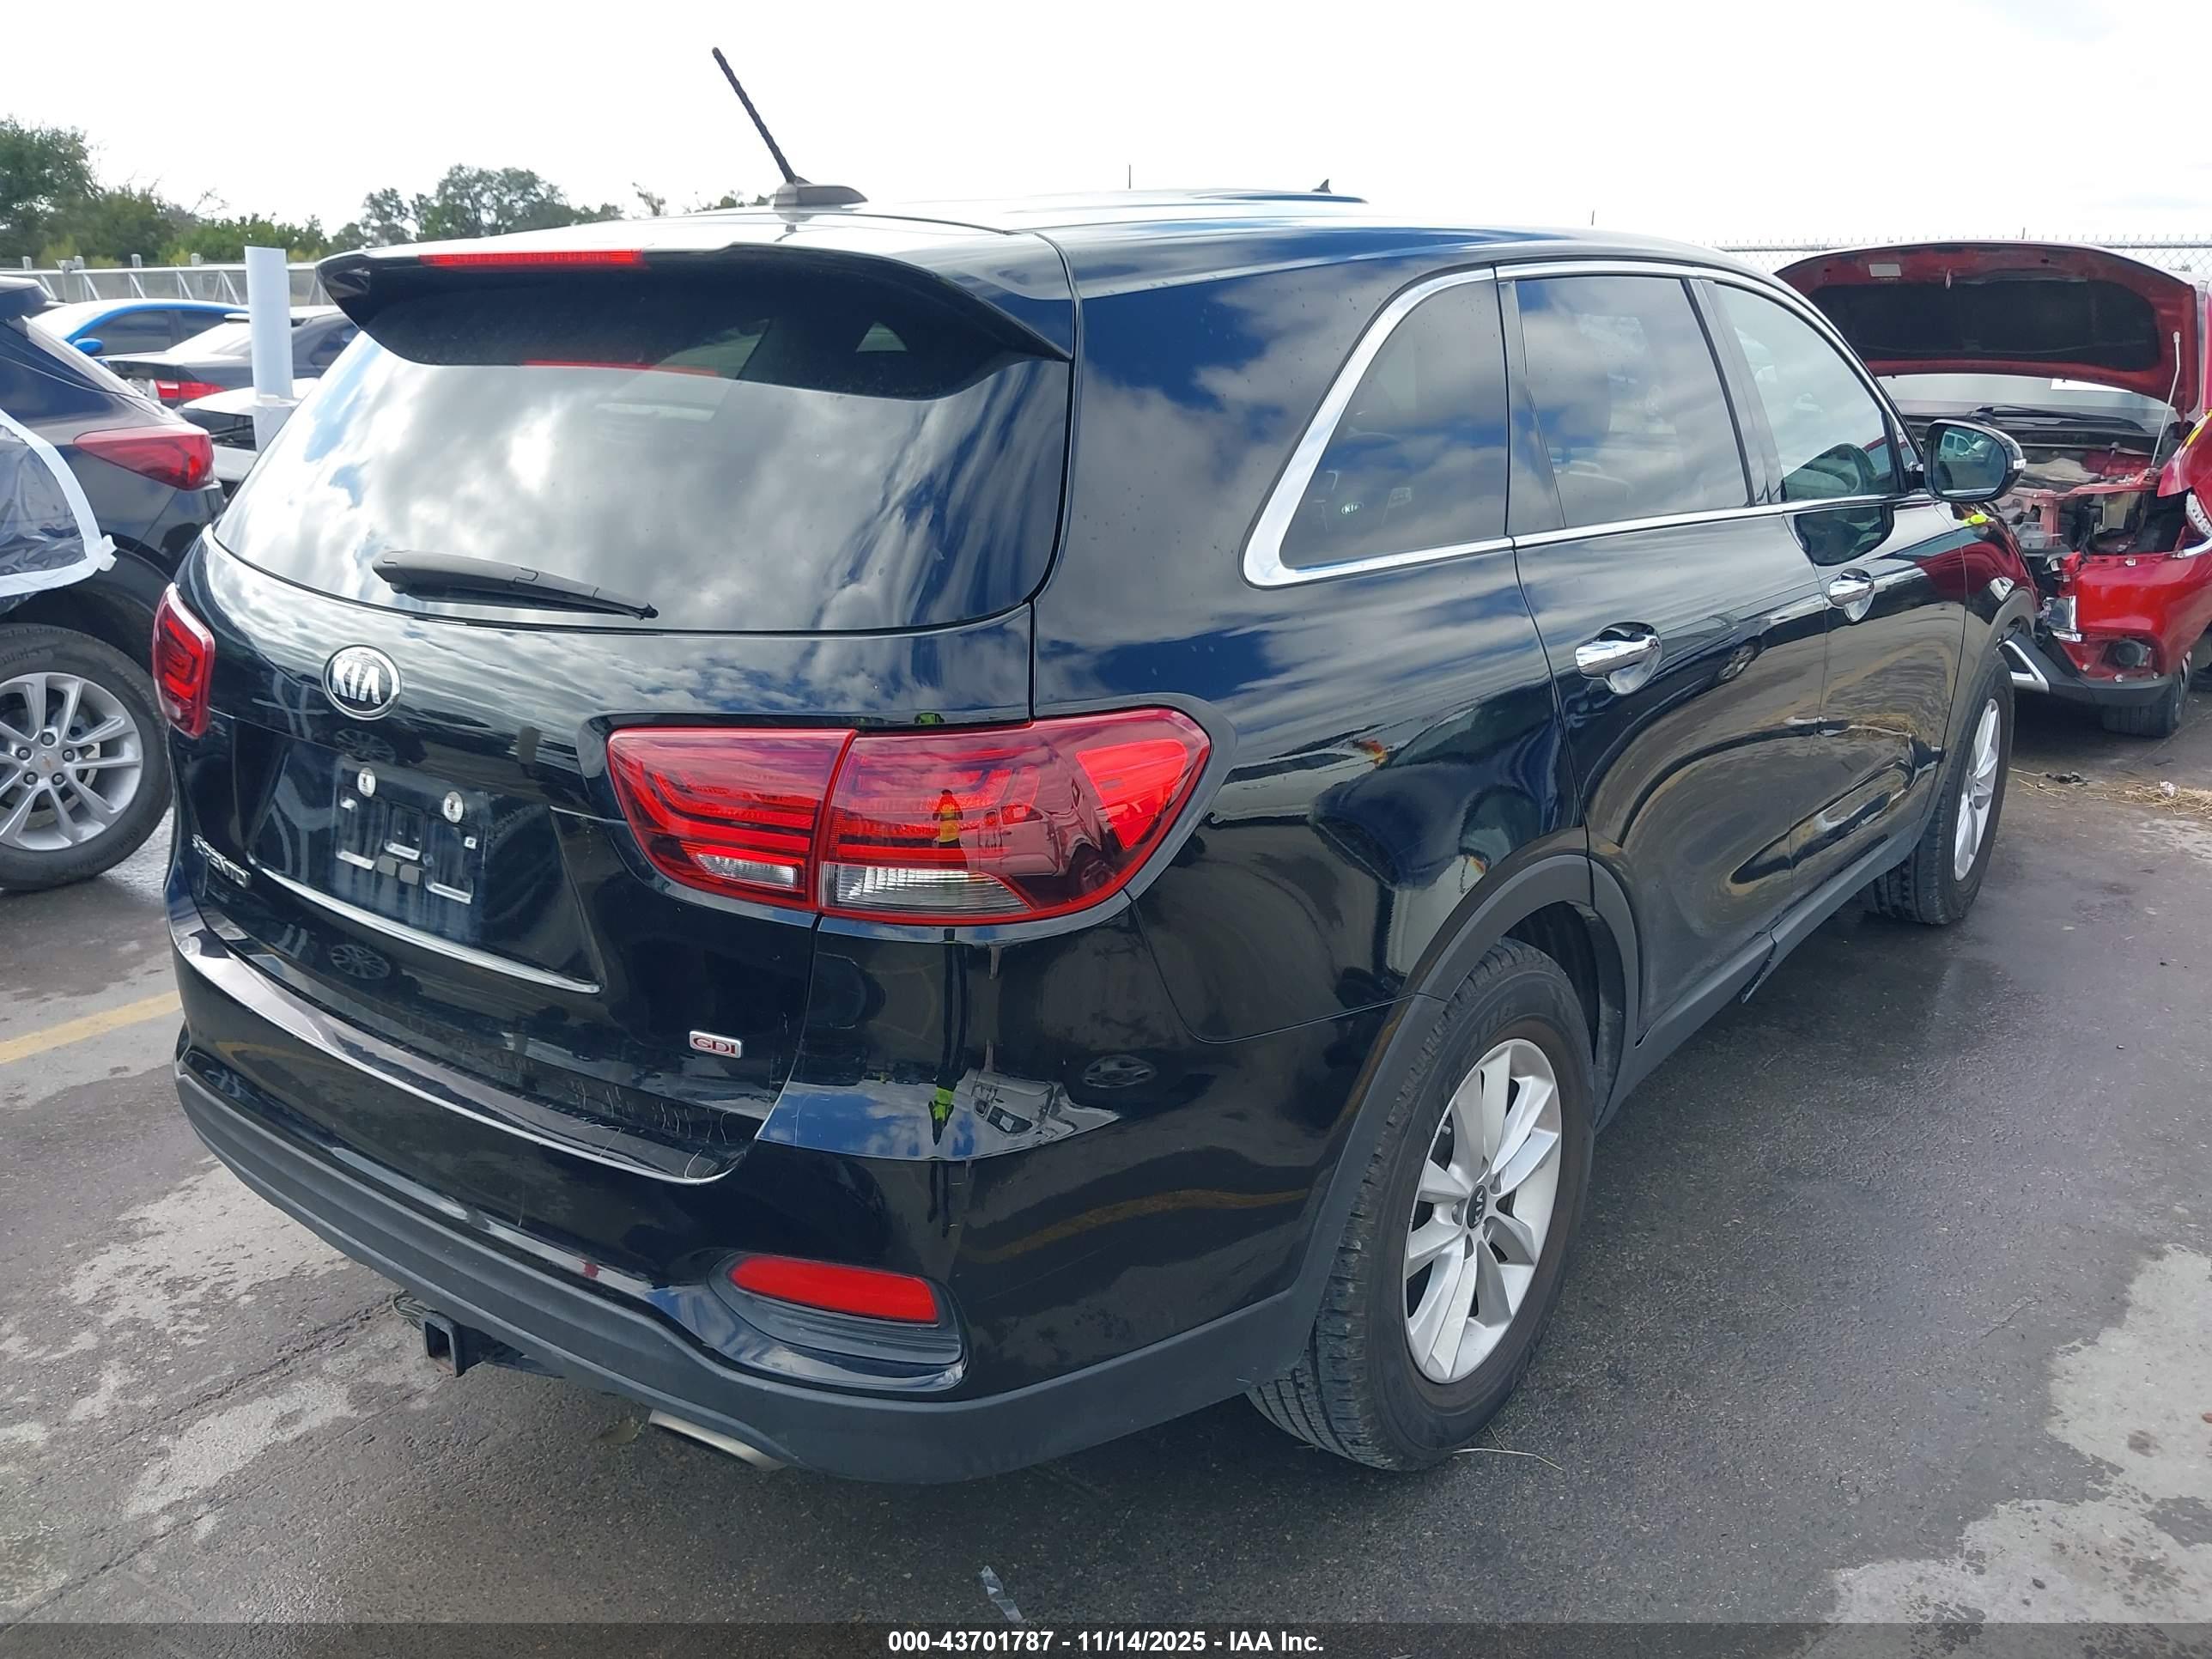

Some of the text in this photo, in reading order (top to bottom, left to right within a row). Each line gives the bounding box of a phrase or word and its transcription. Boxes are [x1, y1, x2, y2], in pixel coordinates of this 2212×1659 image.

[331, 659, 382, 705] KIA
[693, 1036, 736, 1054] GDI
[1473, 1189, 1484, 1224] KIA
